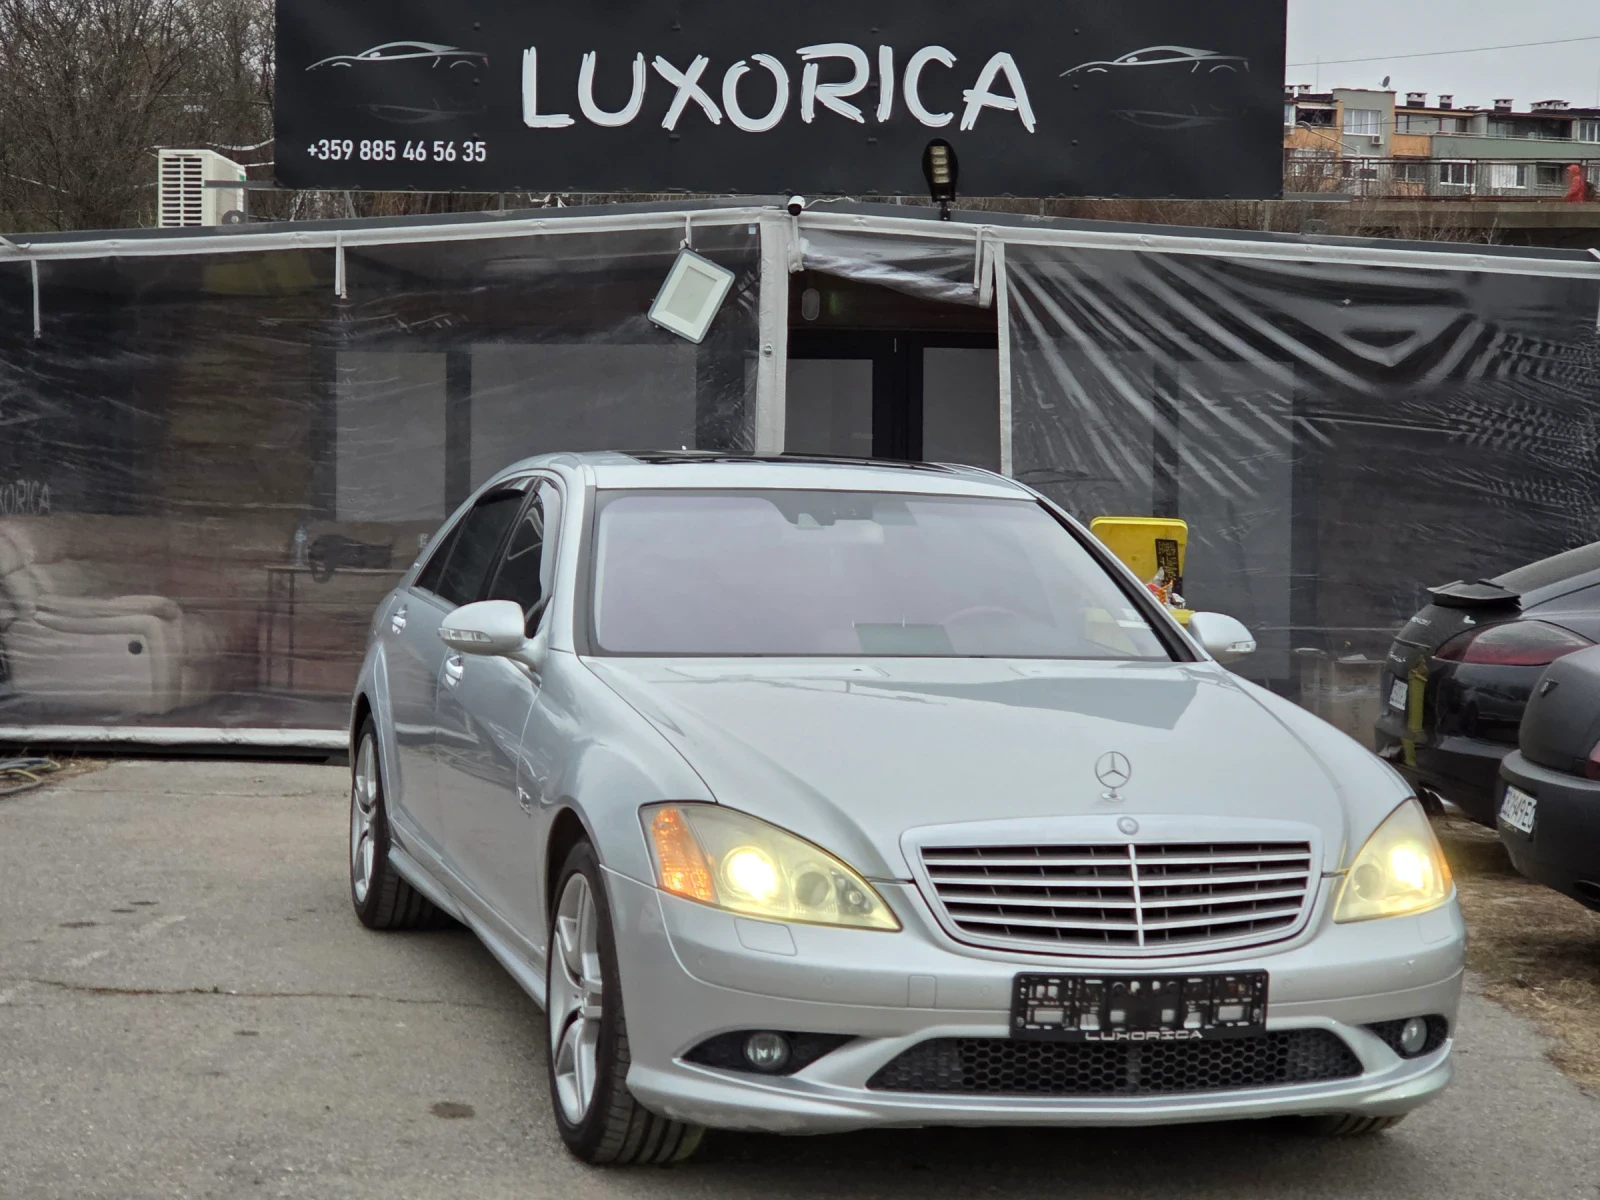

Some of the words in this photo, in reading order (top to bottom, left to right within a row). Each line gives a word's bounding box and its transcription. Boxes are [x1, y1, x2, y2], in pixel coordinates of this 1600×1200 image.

[522, 43, 1037, 134] LUXORICA
[307, 139, 354, 161] +359
[359, 139, 396, 161] 885
[402, 140, 427, 162] 46
[433, 140, 457, 162] 56
[462, 141, 487, 162] 35
[1085, 1030, 1204, 1041] LUXORICA
